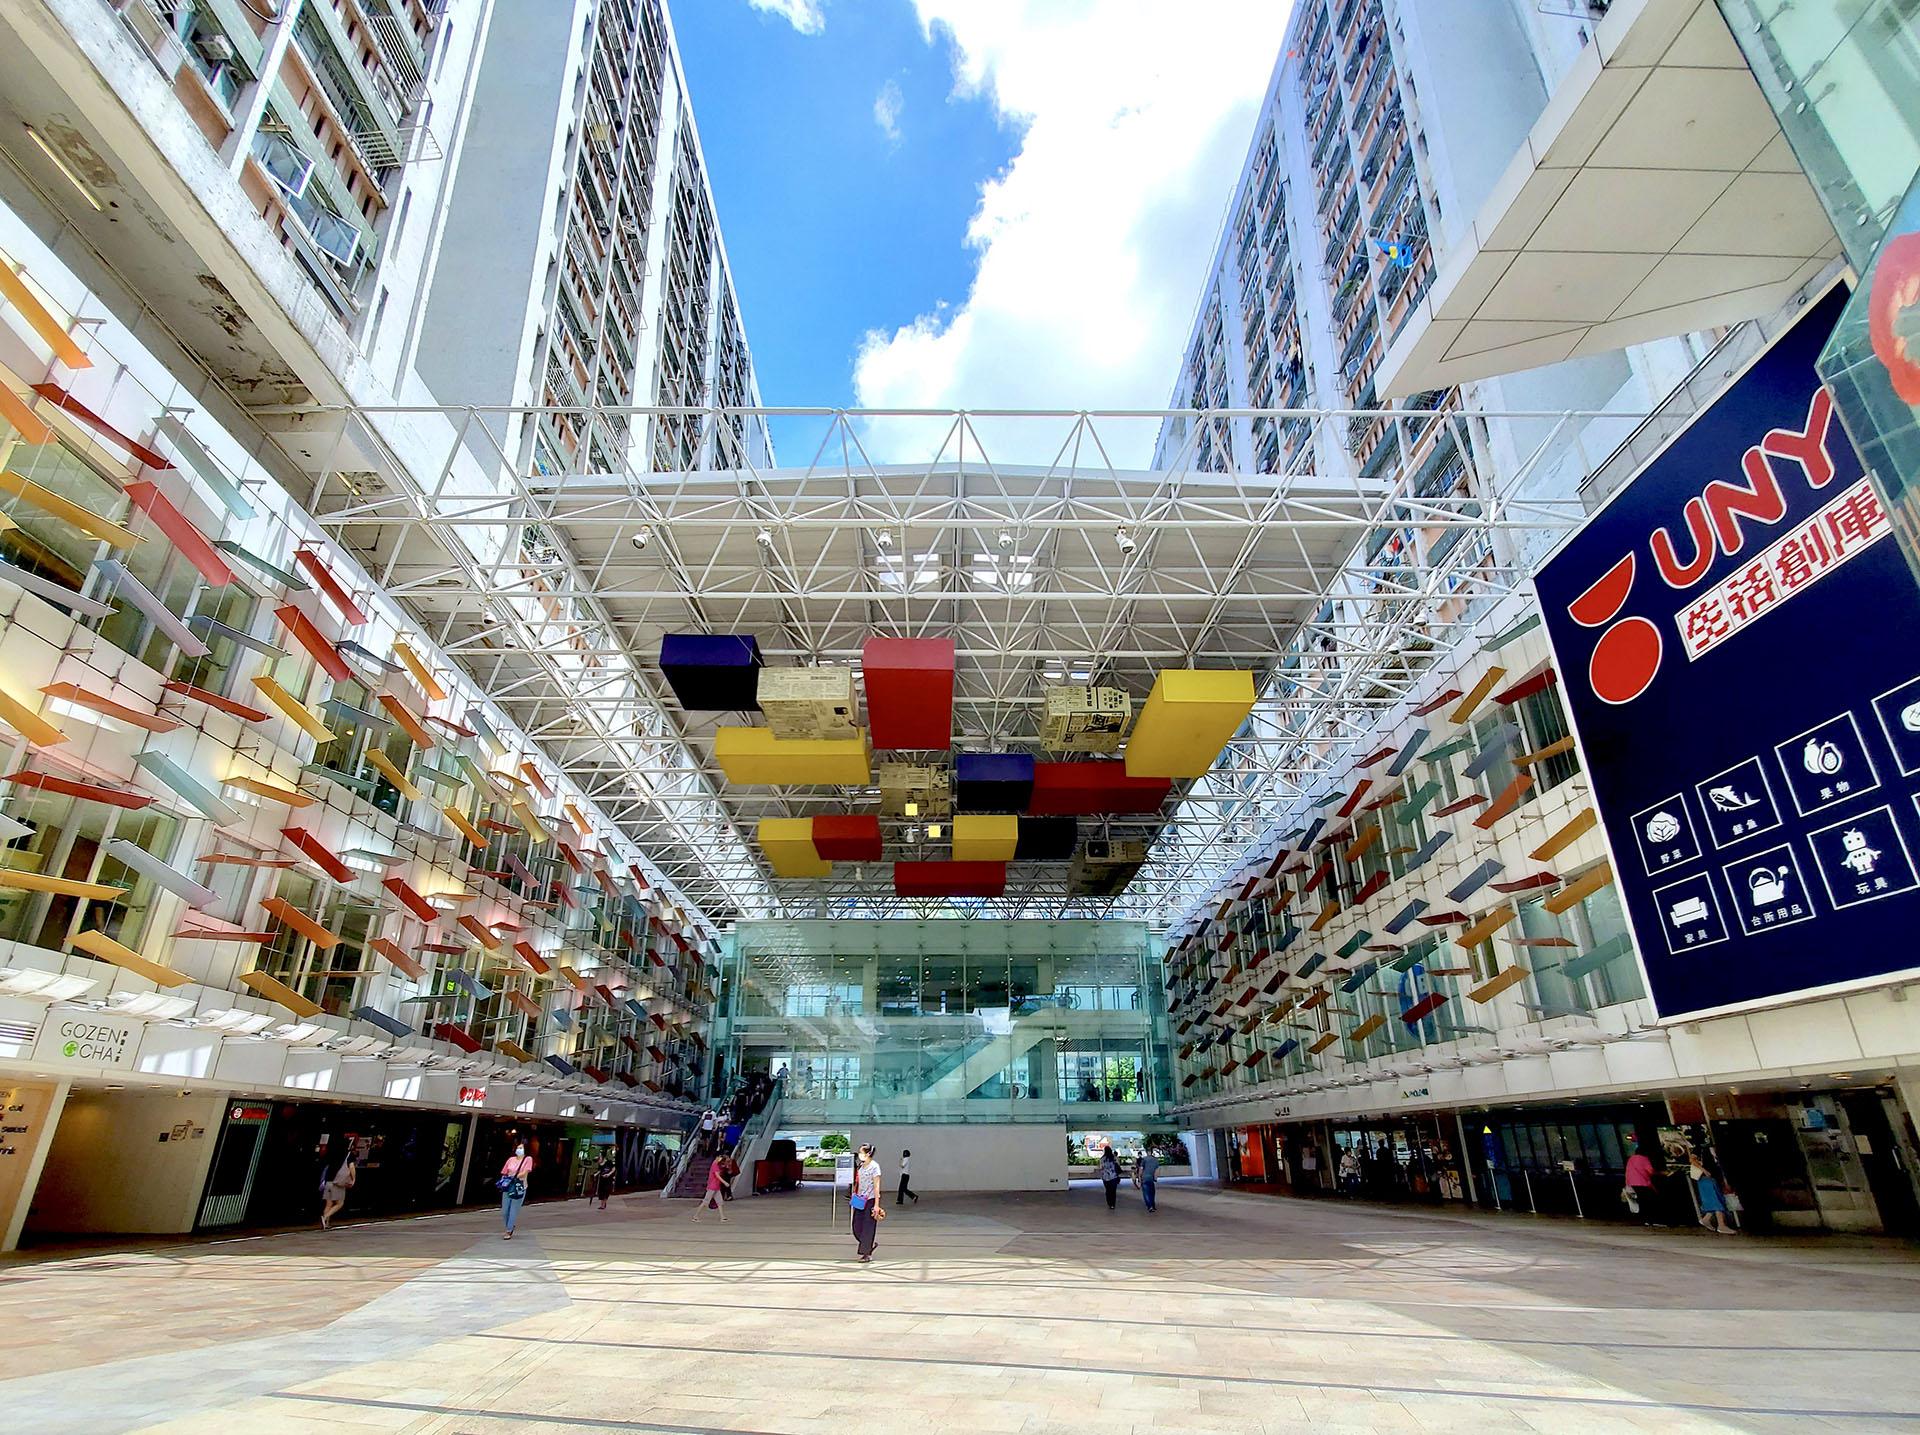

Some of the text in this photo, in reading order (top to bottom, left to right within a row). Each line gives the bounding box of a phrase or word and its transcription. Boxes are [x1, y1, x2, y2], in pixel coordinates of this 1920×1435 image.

[1650, 384, 1835, 589] UNY
[1687, 484, 1886, 650] 生活創庫
[1820, 780, 1850, 800] 果物
[1660, 848, 1682, 864] 野菜
[1856, 876, 1888, 895] 玩具
[1751, 904, 1803, 926] 台所用品
[1685, 929, 1708, 943] 家具
[61, 1021, 121, 1043] GOZEN
